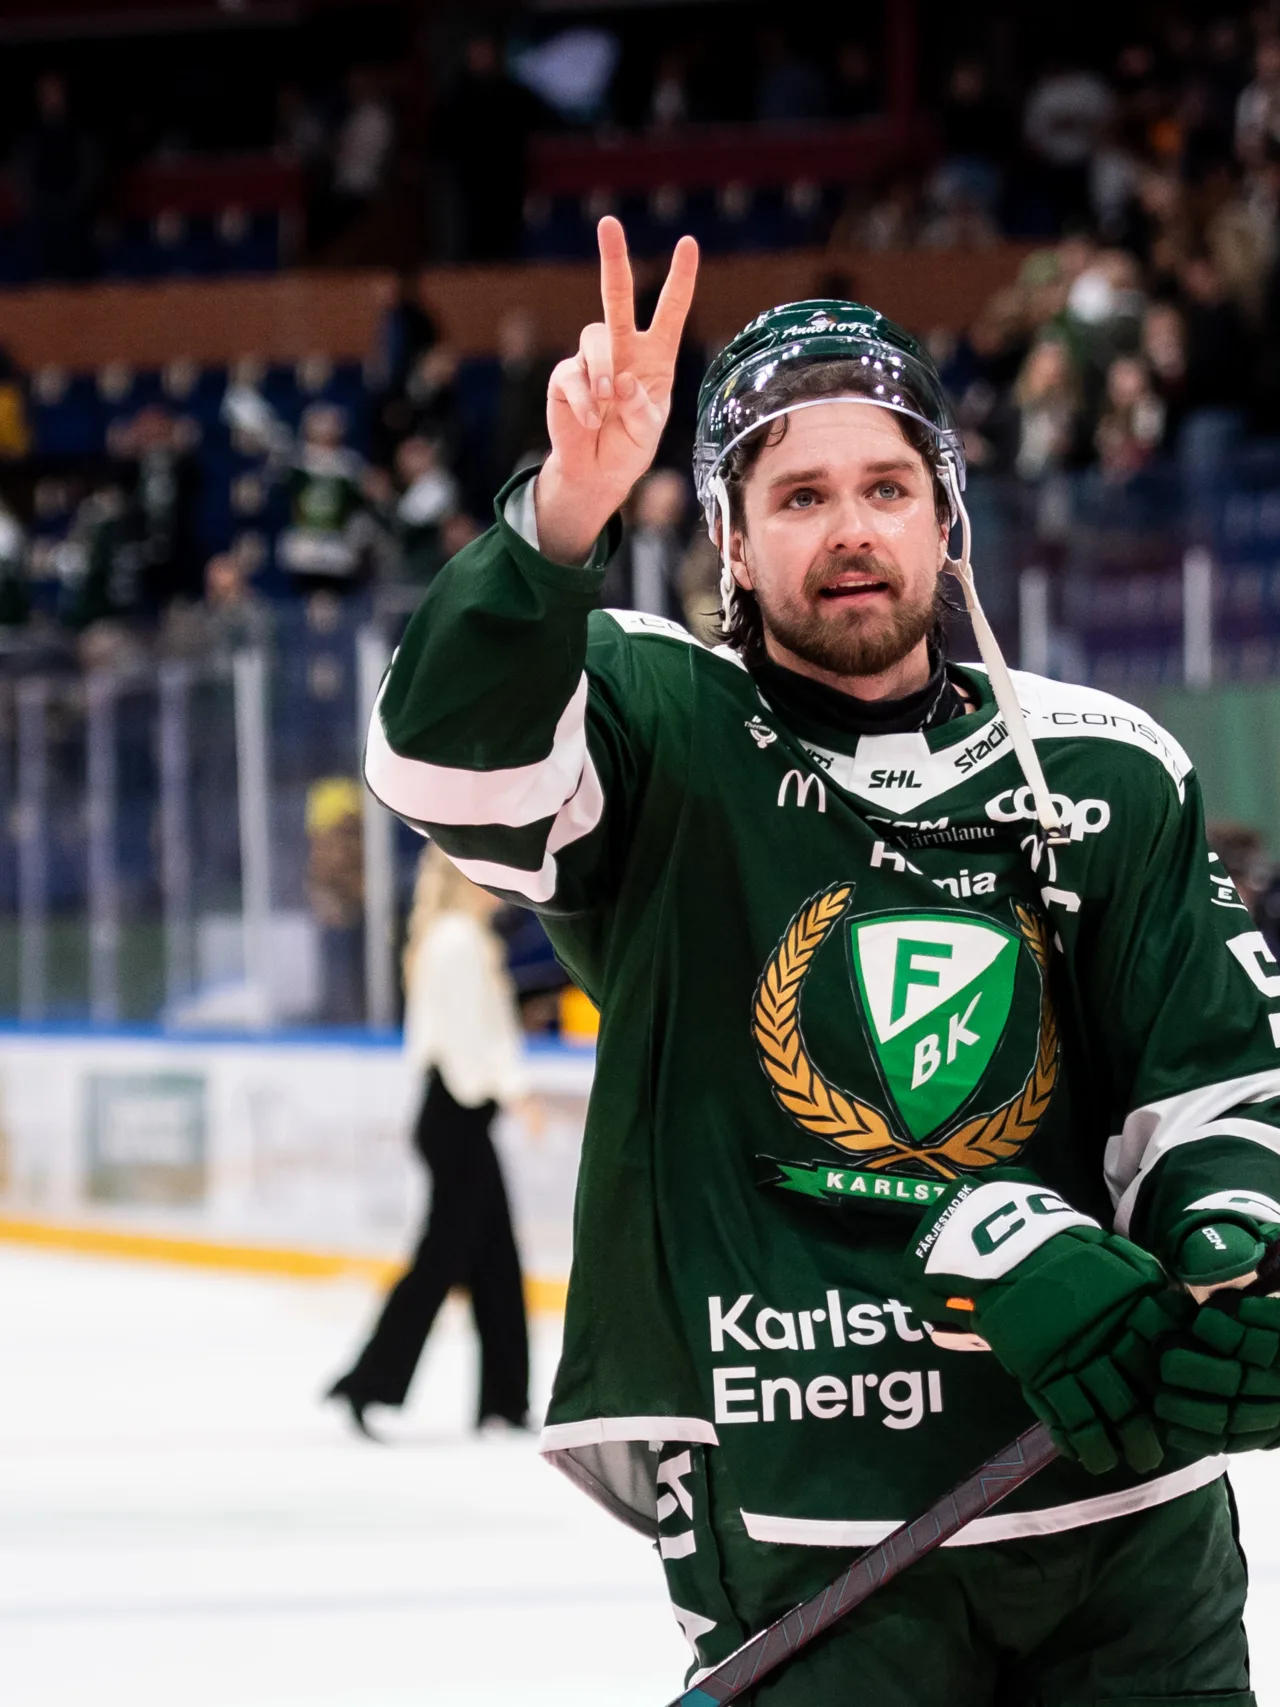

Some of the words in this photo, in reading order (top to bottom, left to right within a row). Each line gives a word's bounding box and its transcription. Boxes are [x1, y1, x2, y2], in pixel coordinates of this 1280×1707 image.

[954, 720, 1009, 774] stadi
[868, 770, 922, 788] SHL
[984, 785, 1110, 842] coop
[826, 1172, 946, 1200] KARLST
[915, 1198, 960, 1259] FÄRJESTAD
[971, 1193, 1076, 1256] CC
[1202, 1227, 1227, 1250] CCM
[708, 1289, 934, 1352] Karlst
